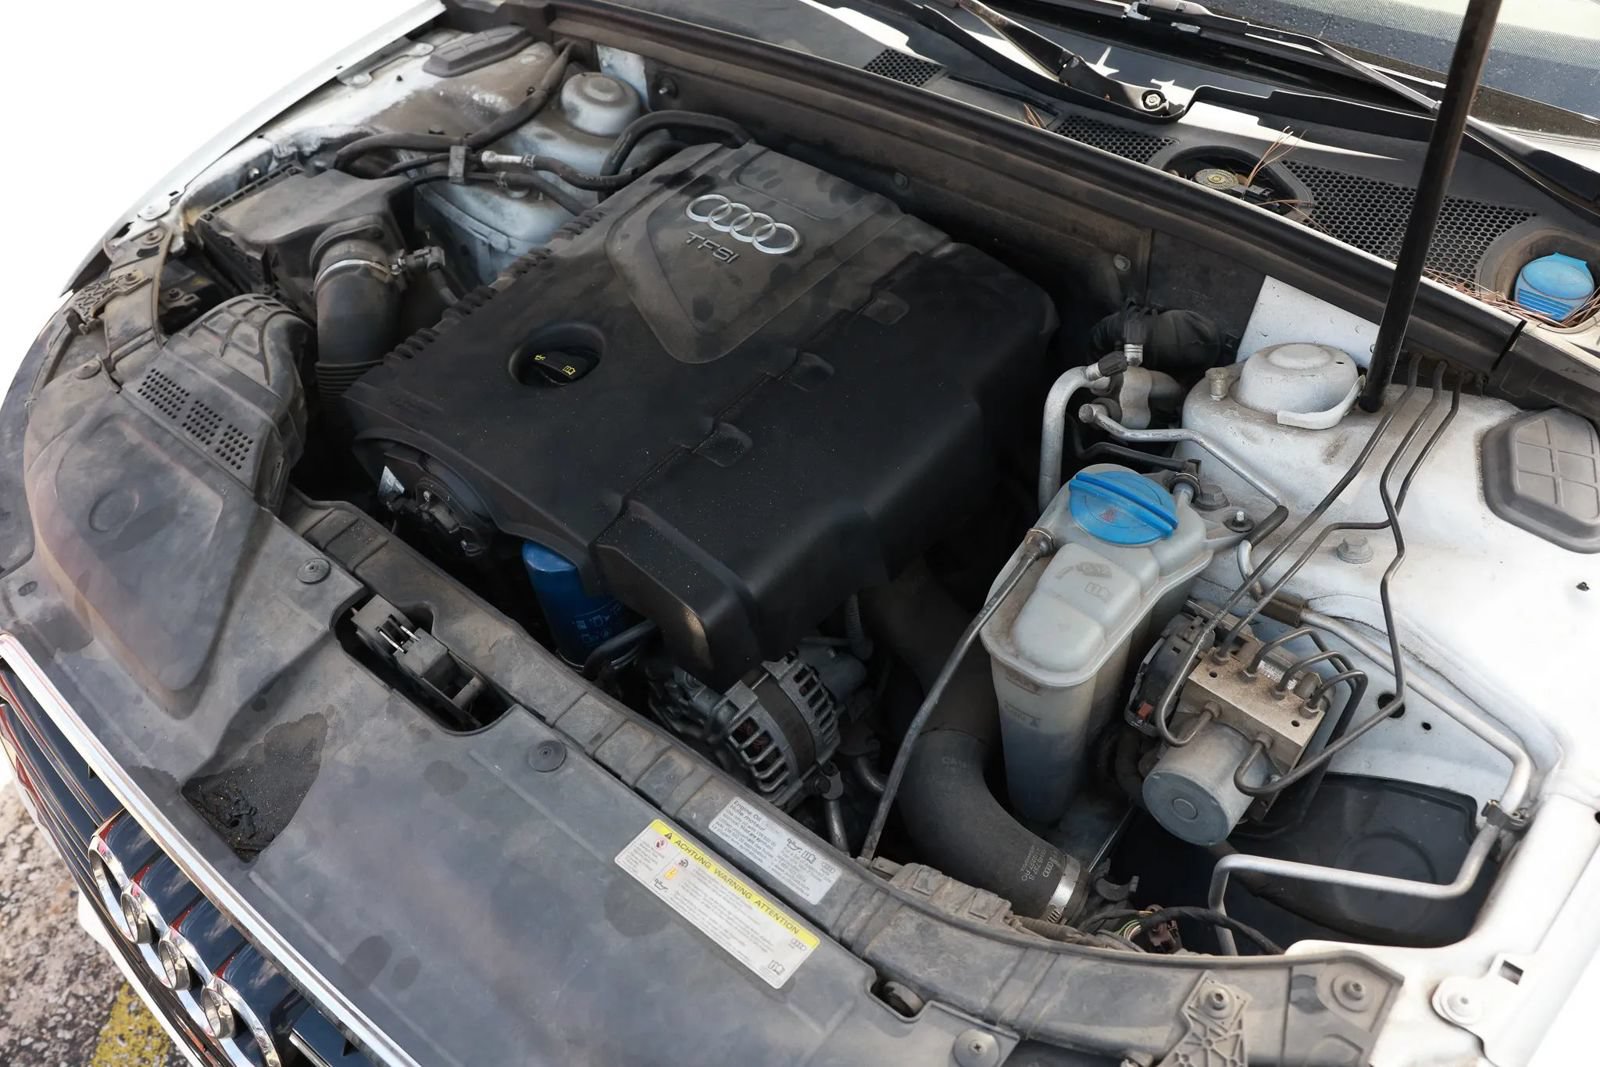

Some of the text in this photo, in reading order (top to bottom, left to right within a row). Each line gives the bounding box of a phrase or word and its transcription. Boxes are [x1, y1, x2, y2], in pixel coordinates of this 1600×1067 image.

[686, 231, 739, 263] TFSI
[675, 840, 712, 868] ACHTUNG
[714, 868, 753, 900] WARNING
[754, 900, 799, 935] ATTENTION
